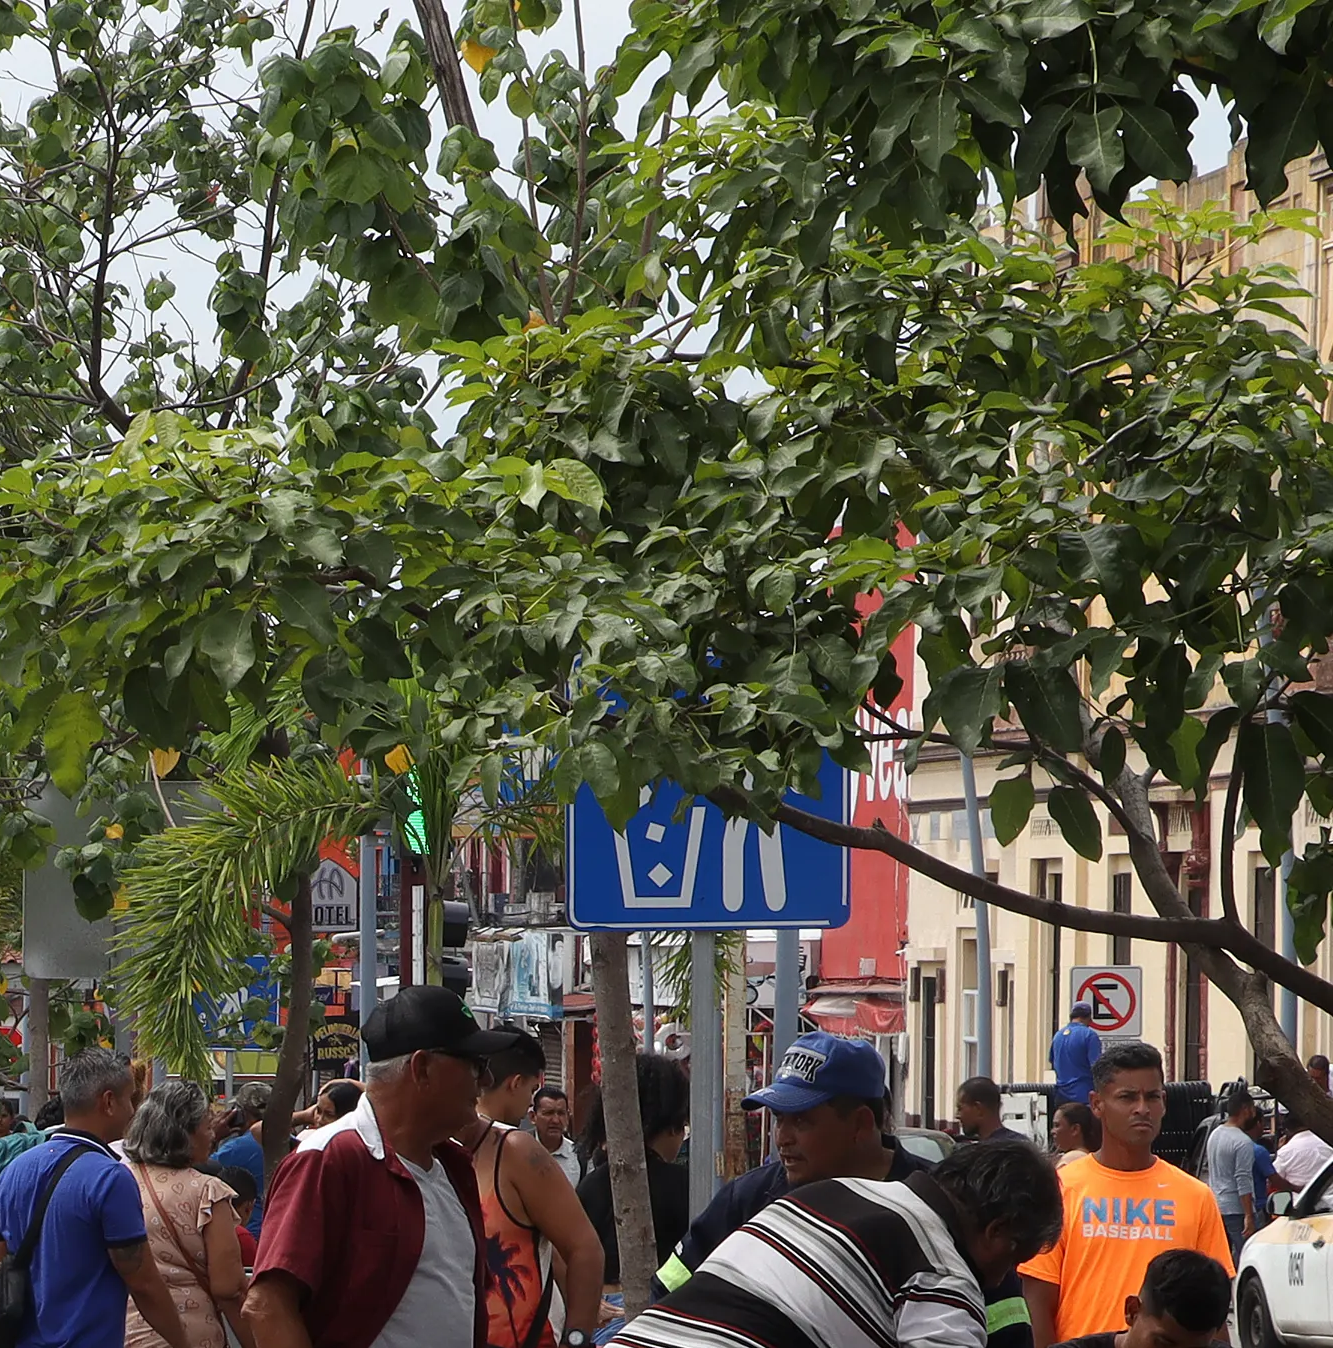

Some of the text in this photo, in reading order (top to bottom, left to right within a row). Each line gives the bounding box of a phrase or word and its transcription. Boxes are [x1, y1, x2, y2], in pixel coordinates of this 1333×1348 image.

[312, 904, 355, 925] OTEL
[1083, 1198, 1175, 1226] NIKE
[1082, 1224, 1174, 1241] BASEBALL
